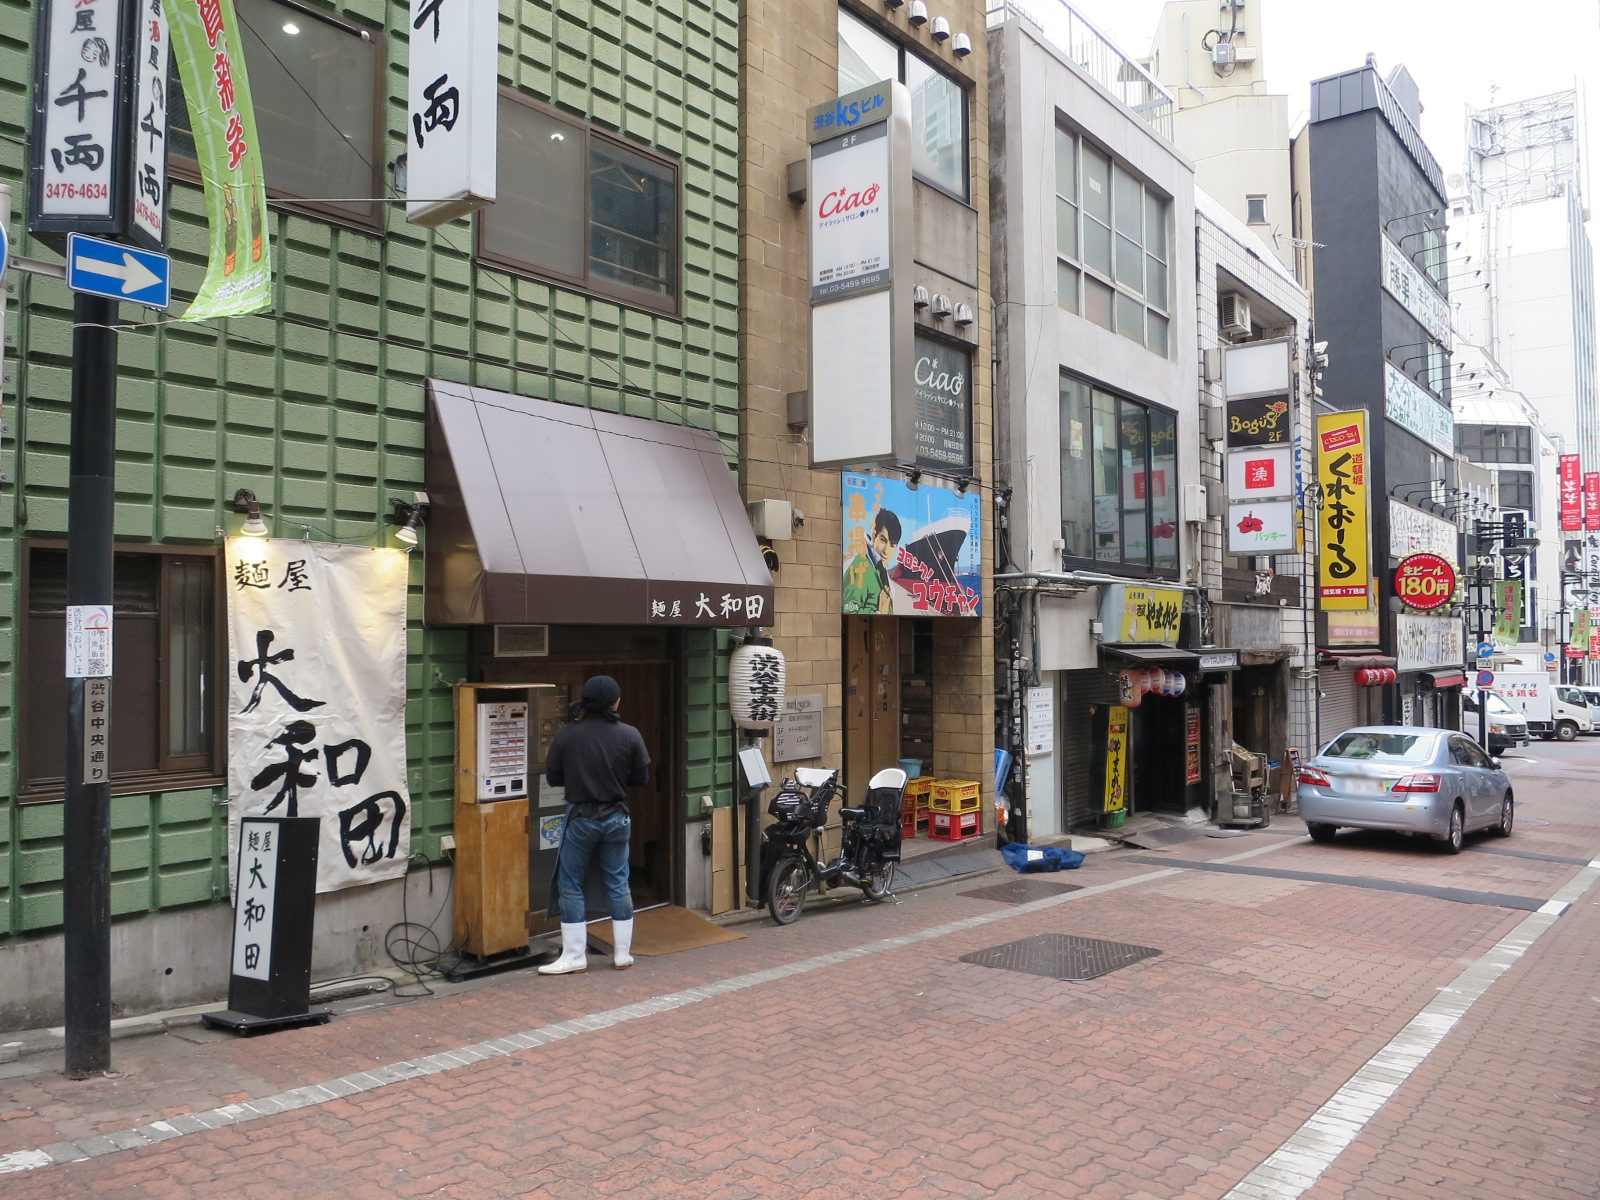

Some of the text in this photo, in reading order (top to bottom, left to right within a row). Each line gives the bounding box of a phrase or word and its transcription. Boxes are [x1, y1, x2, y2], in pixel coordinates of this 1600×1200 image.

[138, 102, 163, 206] 千両
[842, 135, 857, 148] 2F
[46, 183, 108, 199] 3476-4634
[818, 183, 880, 219] Ciao
[135, 199, 162, 231] 3476-4634
[914, 356, 965, 396] Ciao
[1268, 431, 1283, 442] 2F
[1352, 453, 1364, 485] 道頓堀
[1326, 452, 1357, 579] くれおーる
[847, 492, 869, 589] 串揚げ
[1255, 531, 1288, 542] パッキー
[1398, 576, 1449, 596] 180円
[1403, 565, 1444, 577] 生ビール
[695, 592, 764, 619] 大和田
[912, 578, 980, 613] ユウチャン
[748, 653, 780, 722] 渋谷中央街
[91, 683, 105, 780] 渋谷中央通り
[777, 727, 784, 735] 3F
[777, 738, 784, 746] 2F
[237, 629, 407, 869] 大和田
[243, 857, 267, 970] 大和田
